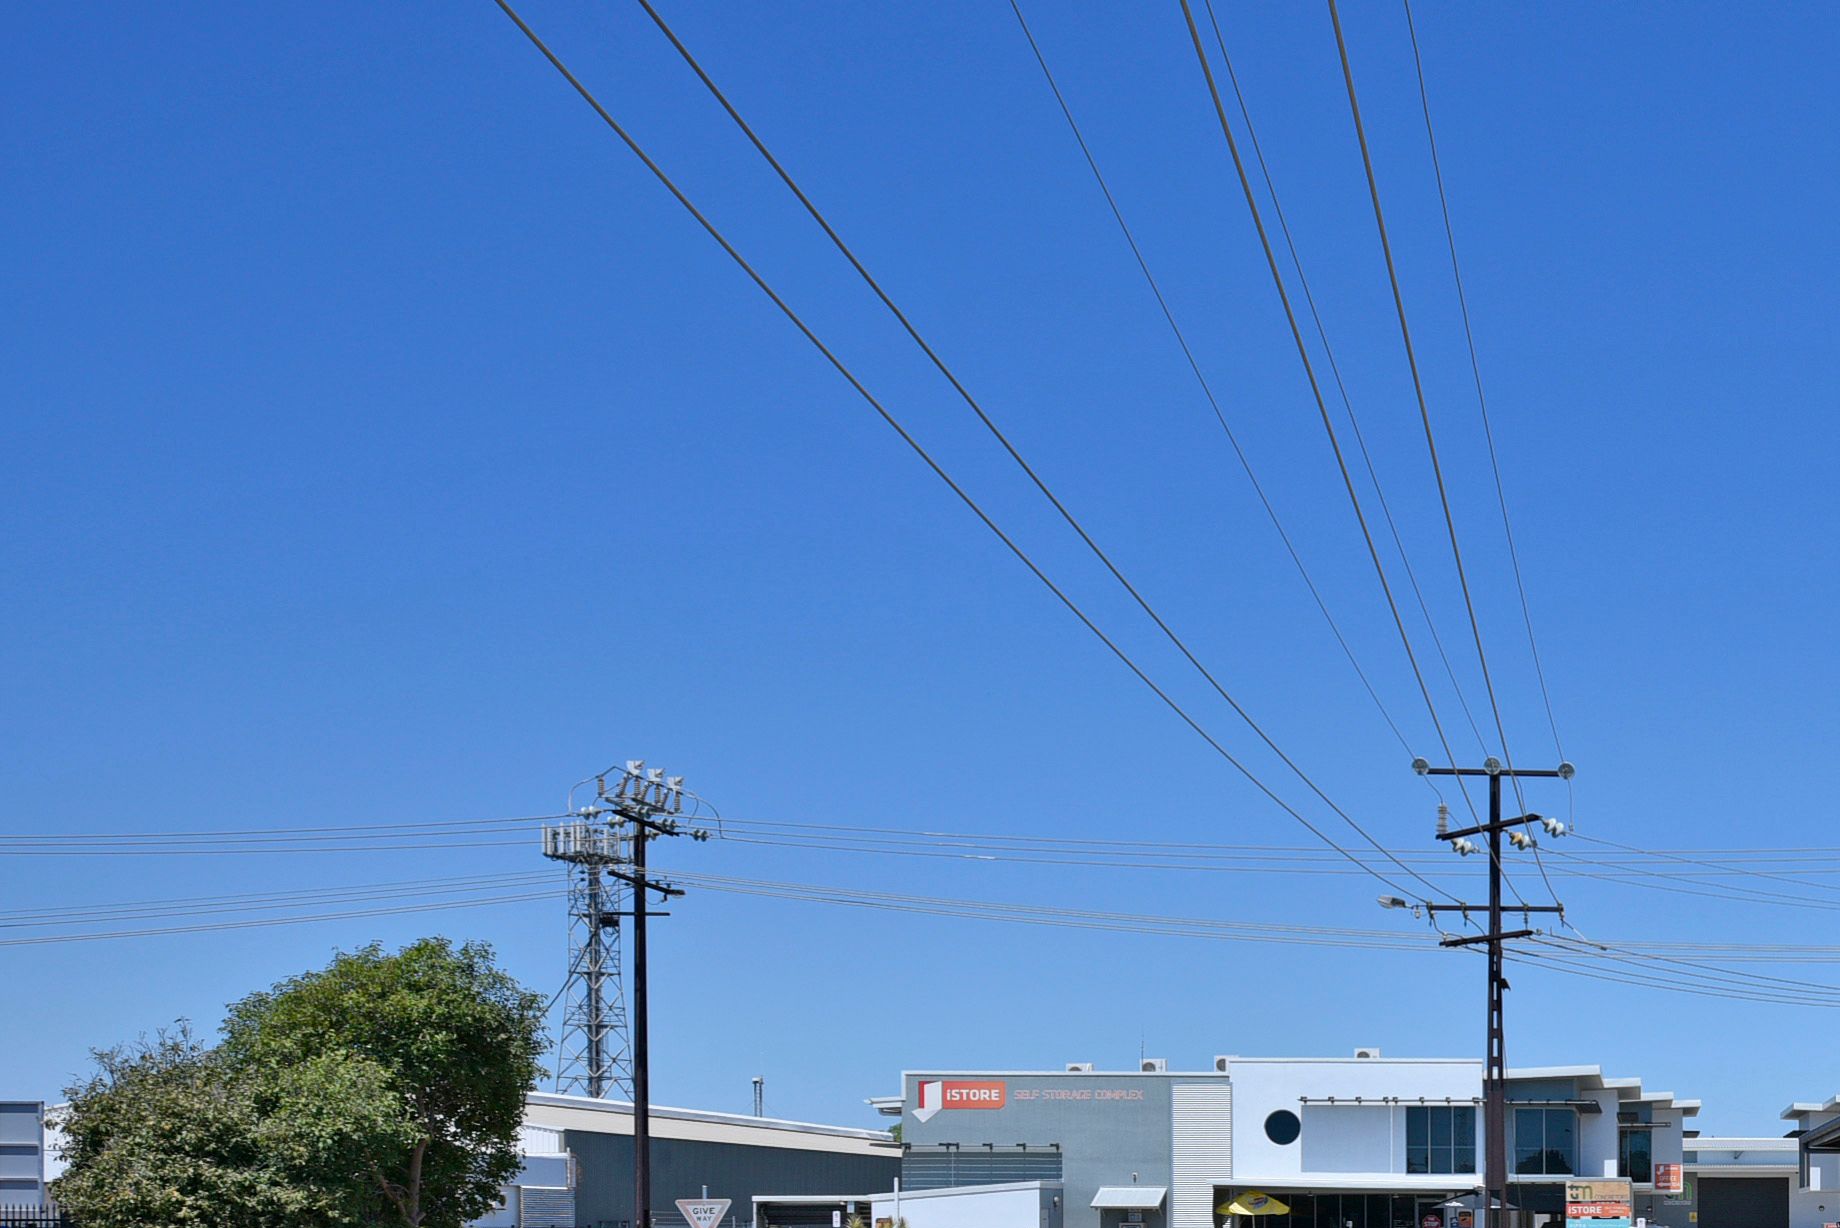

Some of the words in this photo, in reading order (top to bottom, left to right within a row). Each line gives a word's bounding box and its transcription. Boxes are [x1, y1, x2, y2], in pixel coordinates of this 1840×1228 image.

[946, 1089, 1000, 1101] iSTORE
[1014, 1089, 1040, 1100] SELF
[1042, 1089, 1091, 1100] STORAGE
[1095, 1089, 1144, 1100] COMPLEX
[692, 1207, 715, 1215] GIVE
[1568, 1206, 1602, 1214] iSTORE
